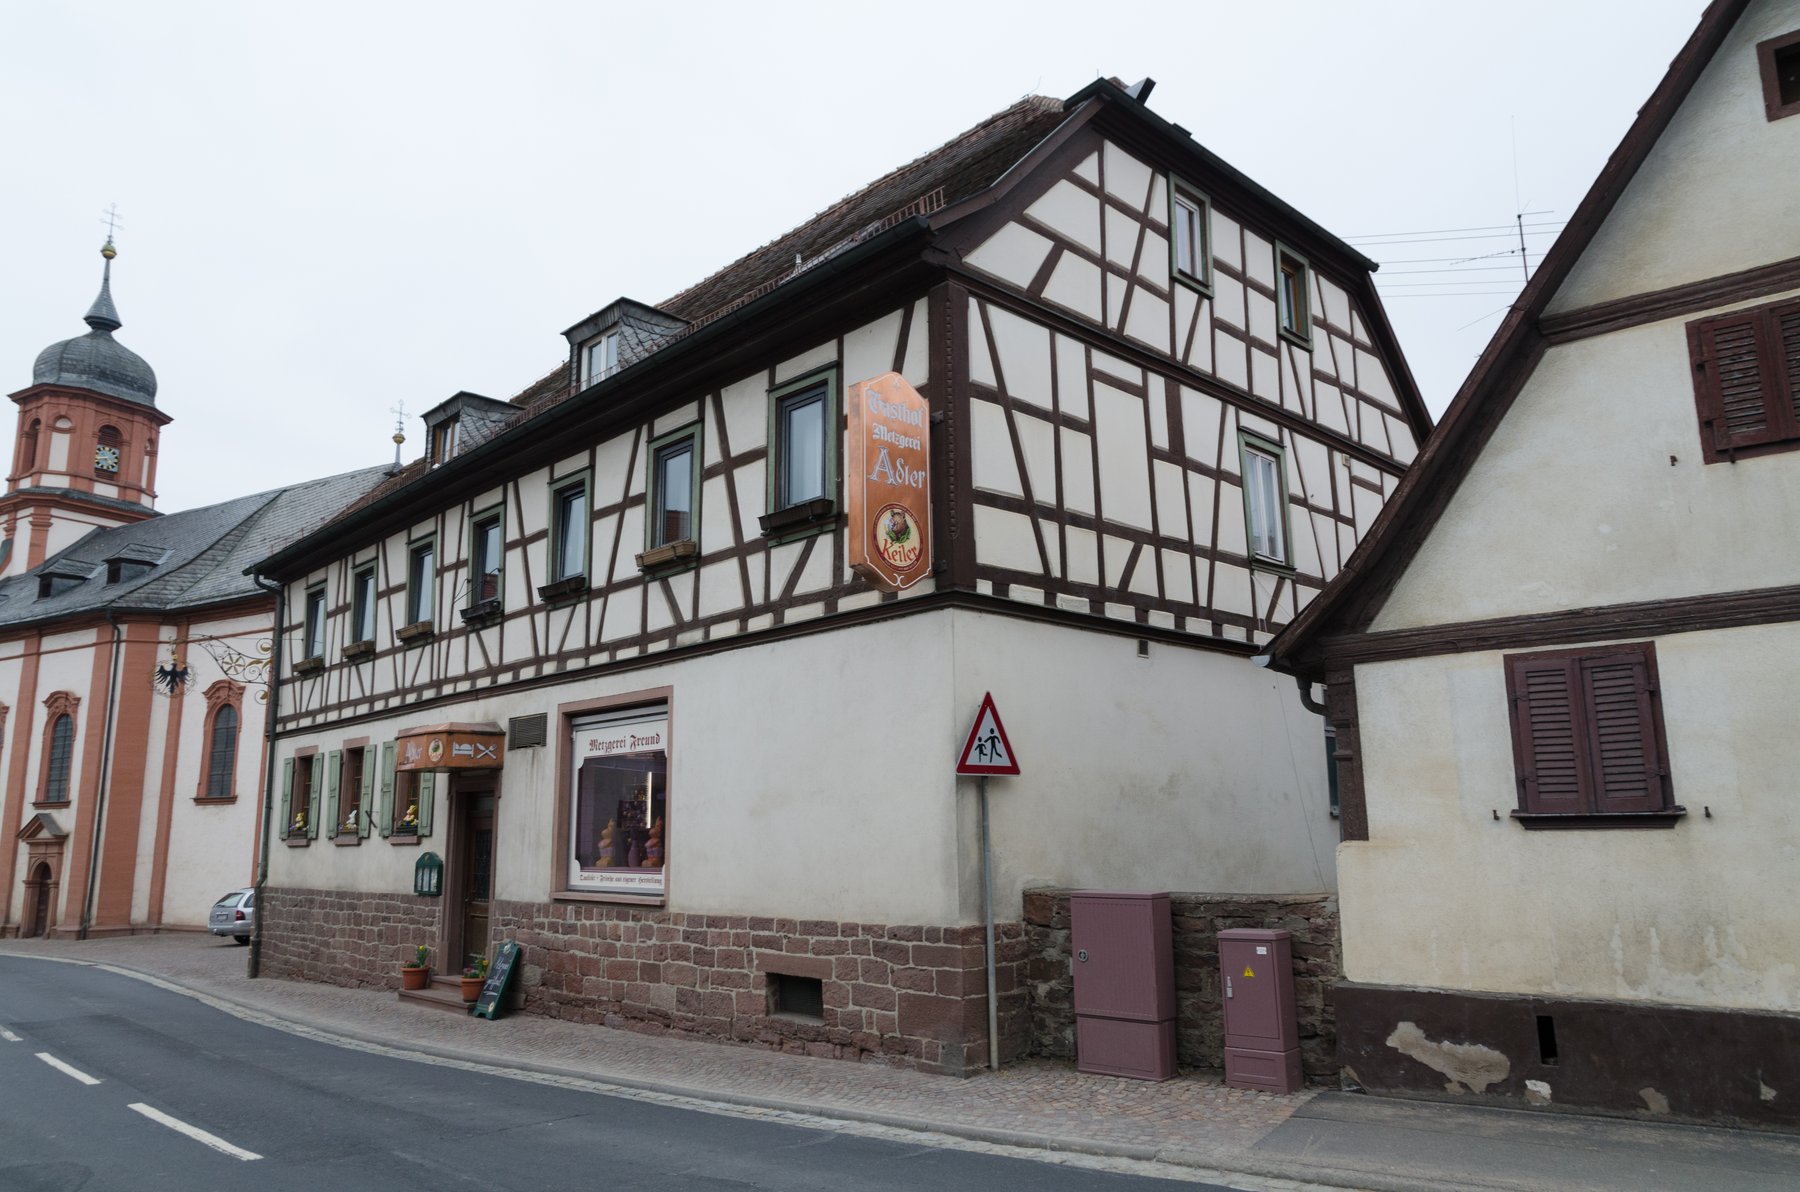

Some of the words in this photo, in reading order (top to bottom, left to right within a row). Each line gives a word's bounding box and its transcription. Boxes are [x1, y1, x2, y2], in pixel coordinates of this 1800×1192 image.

[872, 422, 921, 451] Metzgerei
[868, 446, 926, 489] Adler
[880, 538, 918, 563] Keiler
[589, 735, 627, 753] Metzgerei
[630, 732, 661, 751] Freund
